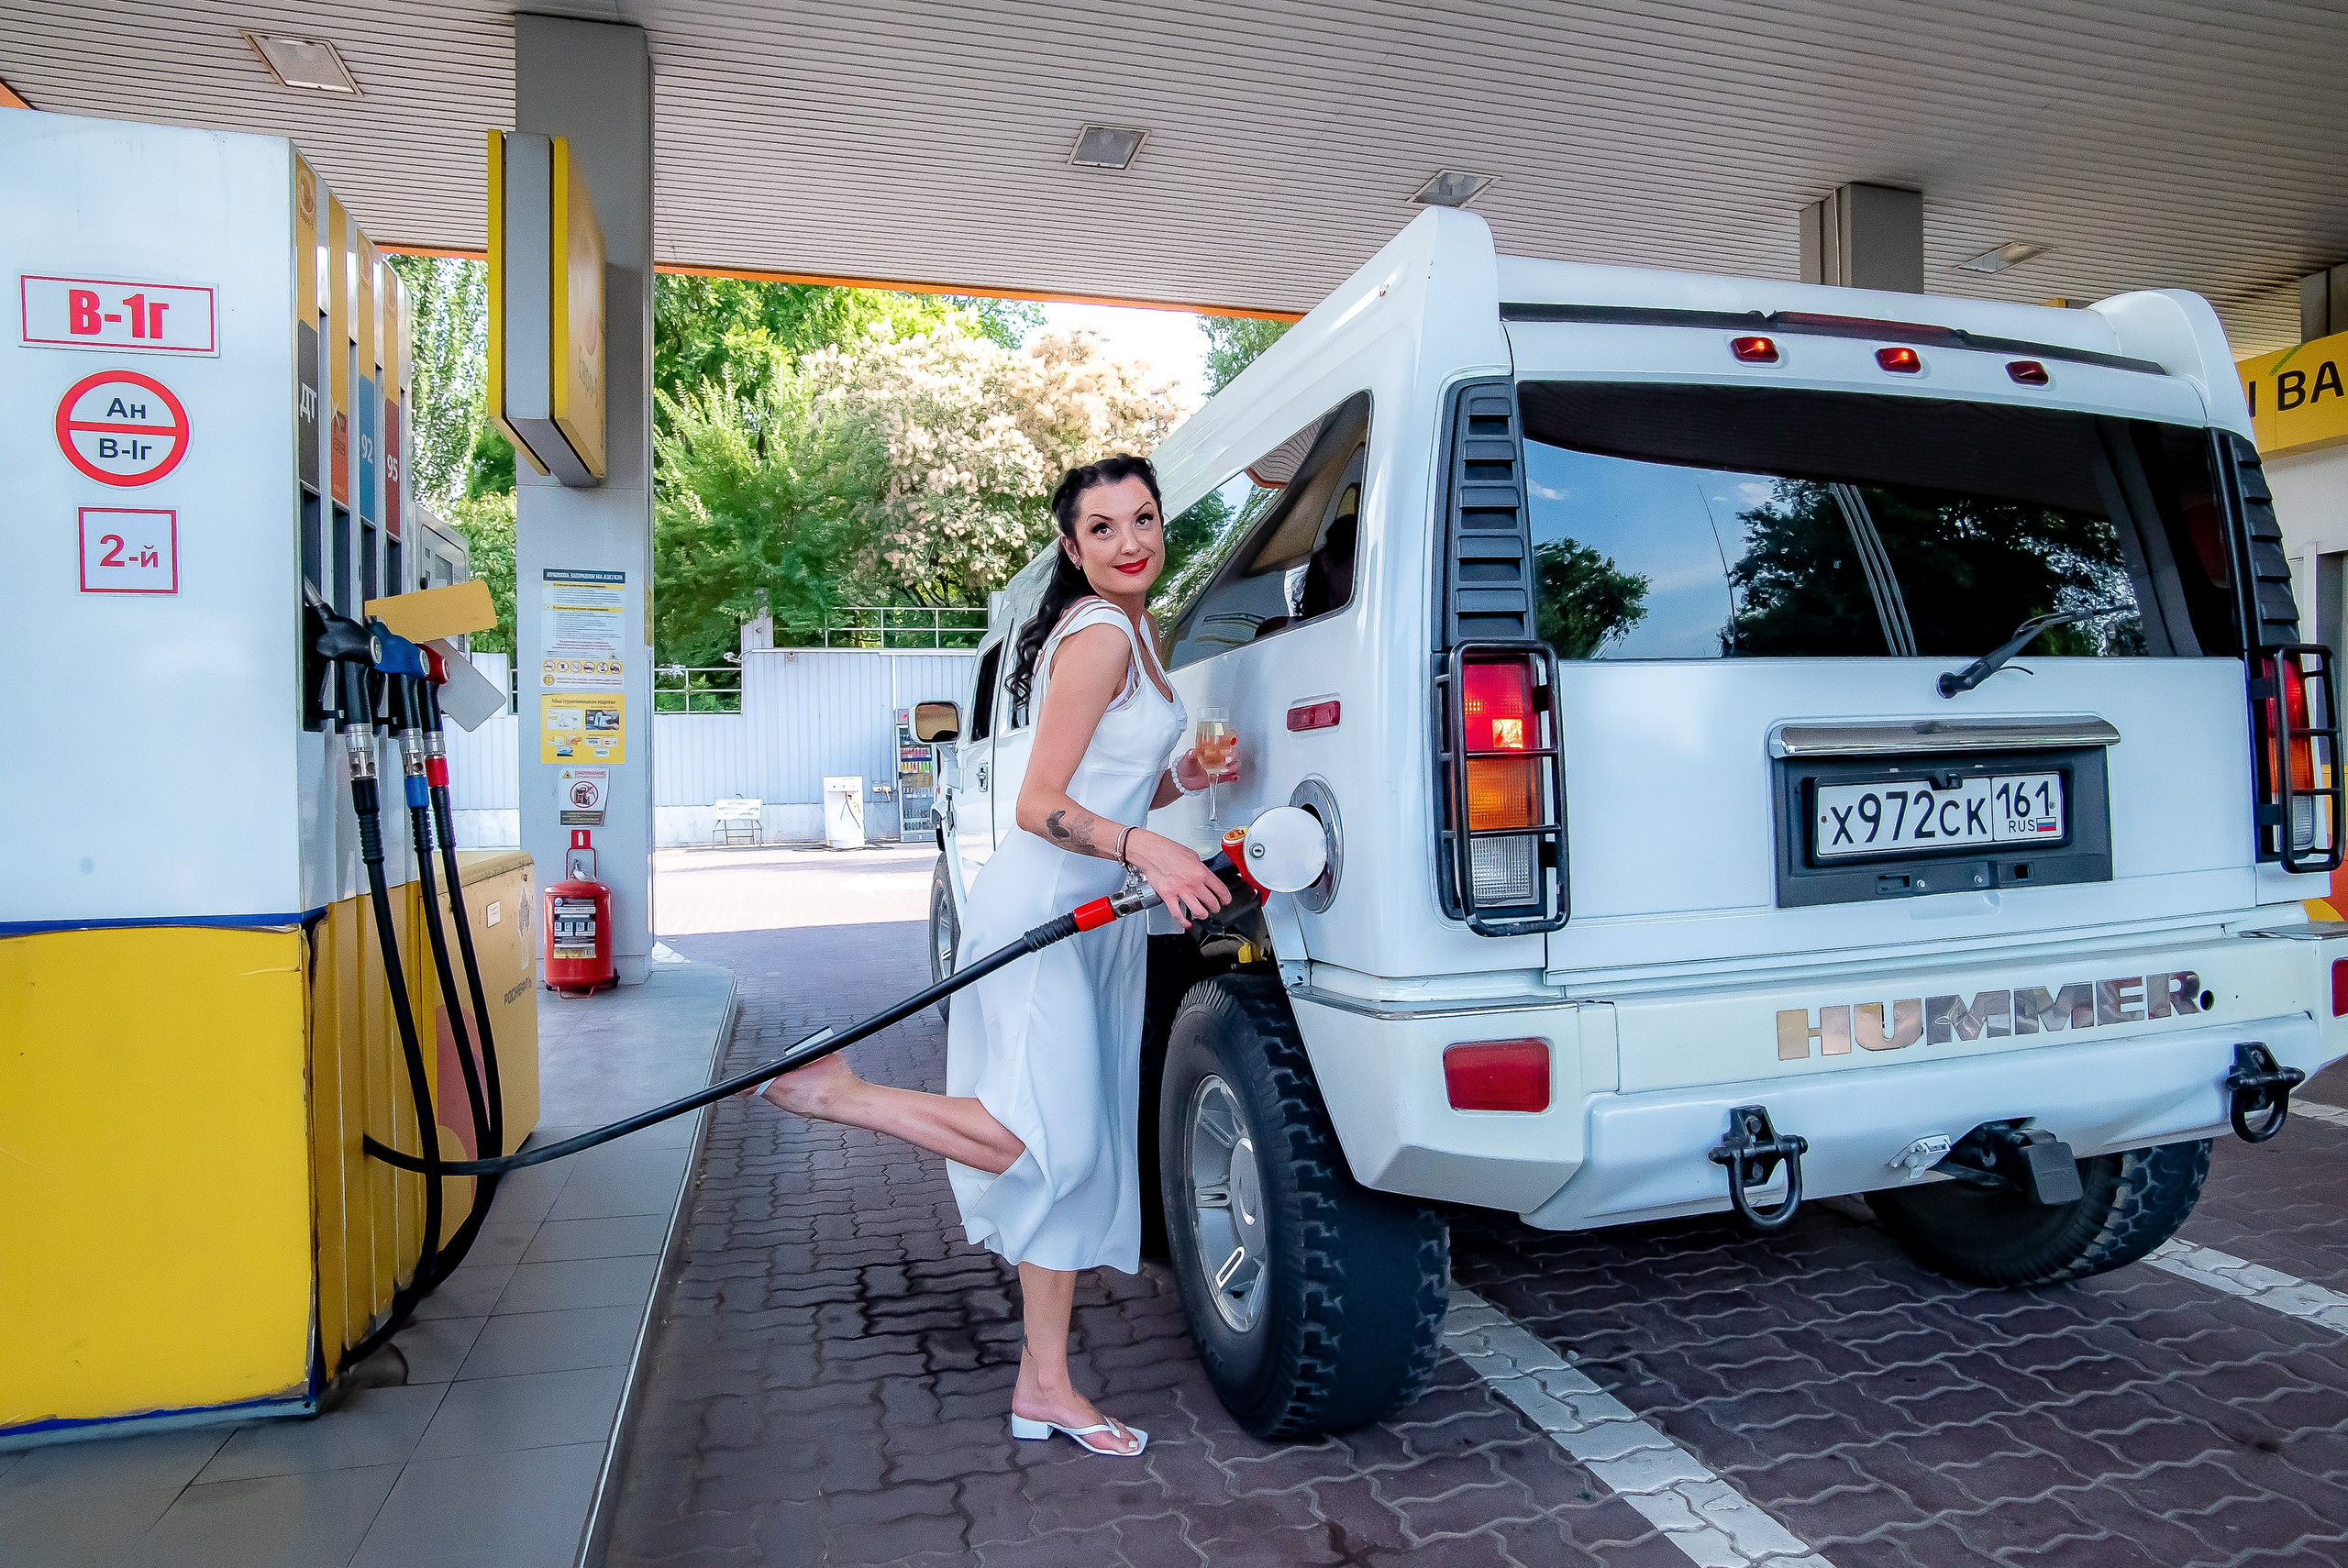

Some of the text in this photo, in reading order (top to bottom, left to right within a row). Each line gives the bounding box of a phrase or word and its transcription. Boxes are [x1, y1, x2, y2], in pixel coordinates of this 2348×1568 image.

[68, 289, 170, 339] В-1г
[106, 397, 147, 420] Ан
[300, 382, 317, 424] ДТ
[361, 433, 373, 466] 92
[387, 454, 398, 482] 95
[99, 534, 160, 569] 2-й
[1995, 780, 2051, 820] 161
[2008, 819, 2036, 834] RUS
[1777, 970, 2202, 1061] HUMMER
